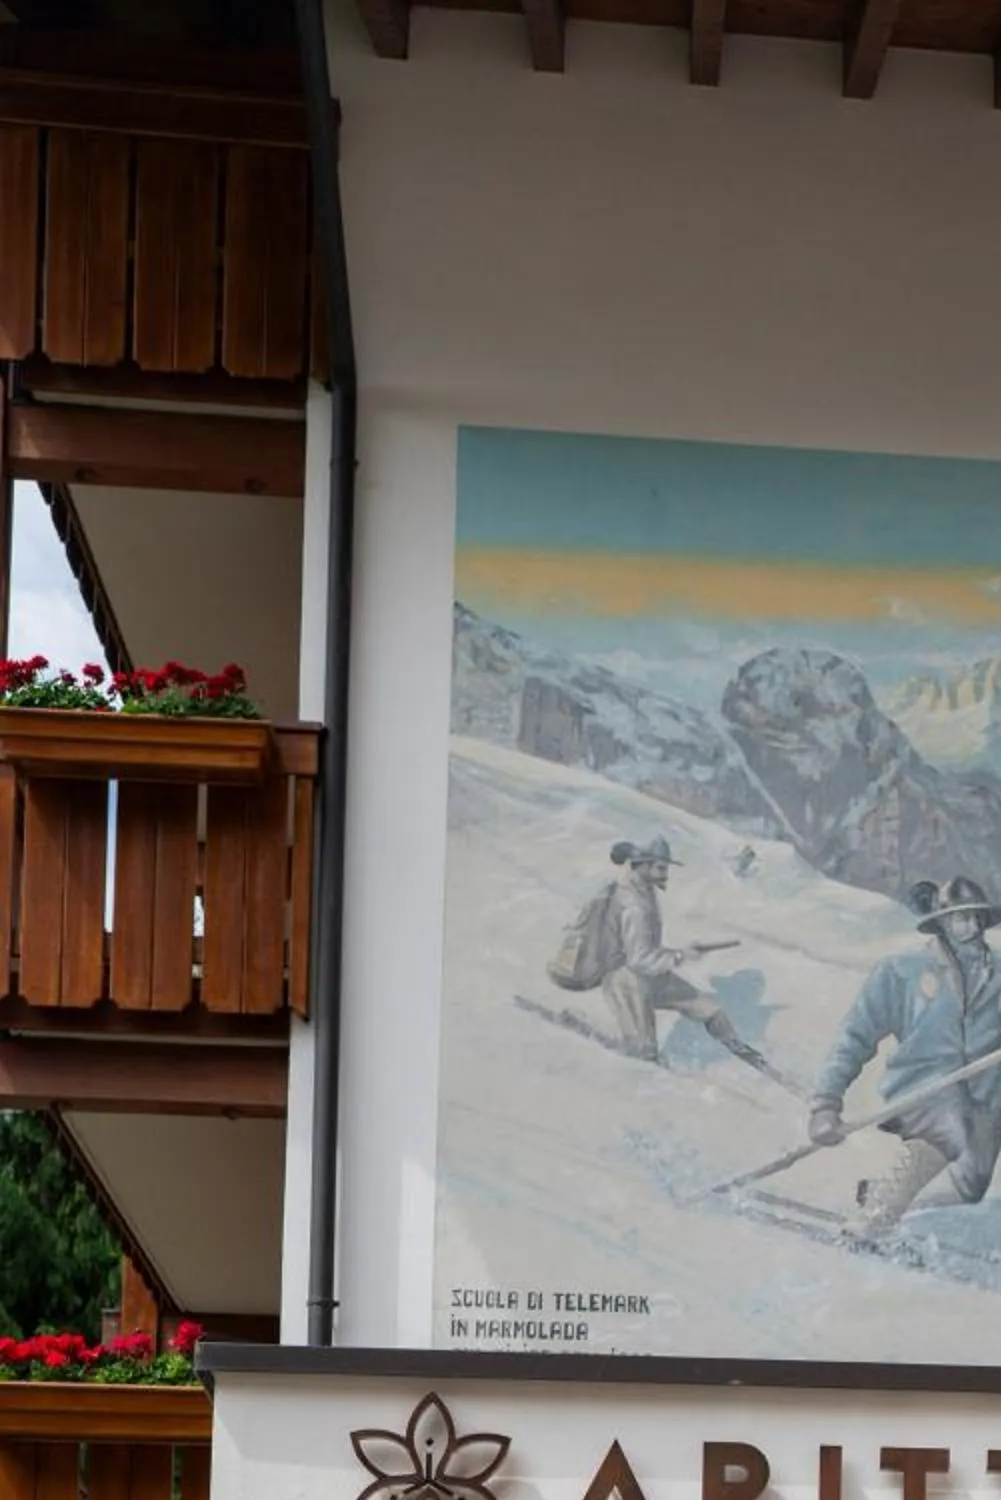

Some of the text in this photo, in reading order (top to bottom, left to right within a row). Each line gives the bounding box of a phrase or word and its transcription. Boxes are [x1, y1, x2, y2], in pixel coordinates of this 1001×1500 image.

[451, 1289, 651, 1314] SCUOLA DI TELEMARK
[475, 1320, 589, 1340] MARMOLADA
